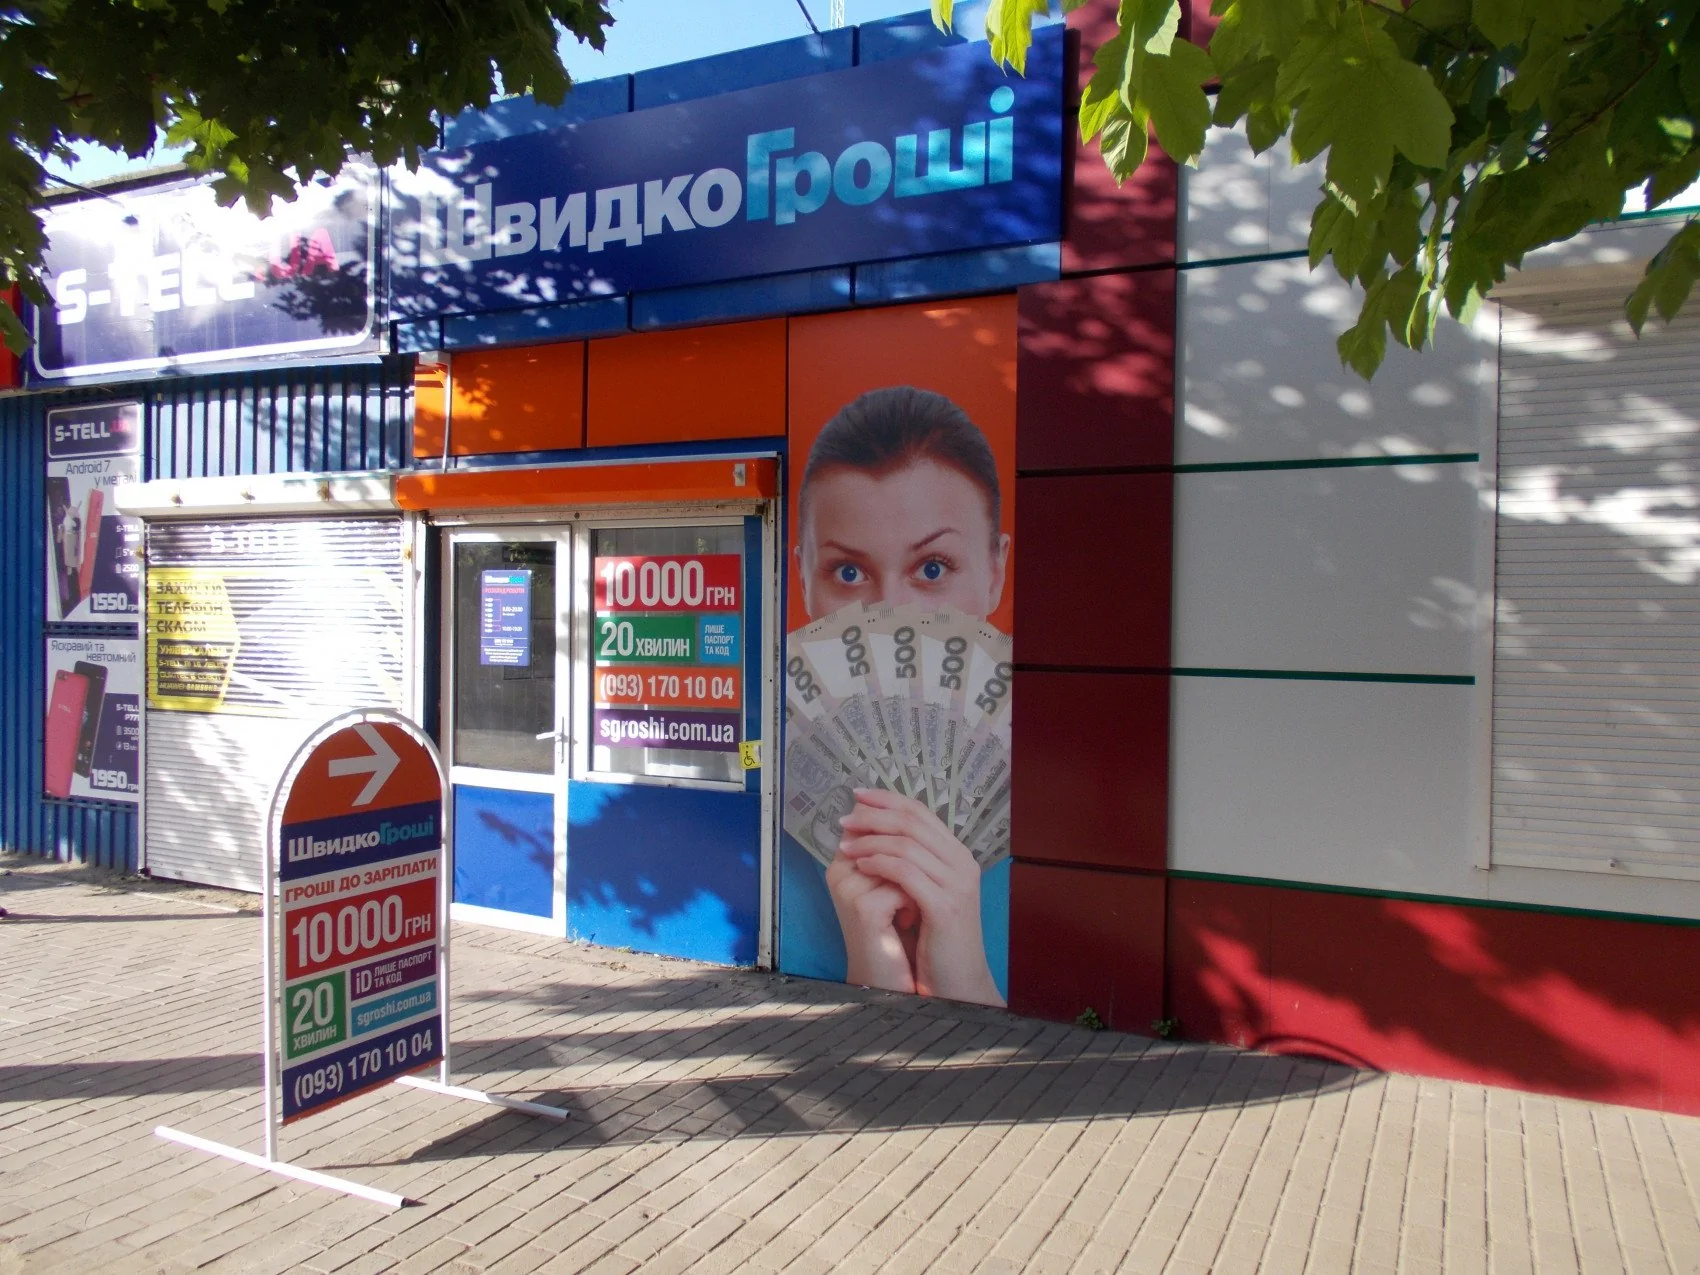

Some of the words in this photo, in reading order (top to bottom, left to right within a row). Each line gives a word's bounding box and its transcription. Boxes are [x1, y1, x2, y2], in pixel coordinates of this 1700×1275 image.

[419, 86, 1015, 267] ШвидкоГроші
[65, 461, 103, 475] Android
[104, 460, 111, 474] 7
[600, 561, 636, 607] 10
[640, 560, 704, 607] 000
[706, 586, 735, 606] ГРН
[91, 592, 128, 611] 1550
[600, 621, 634, 656] 20
[636, 638, 690, 657] ХВИЛИН
[704, 624, 725, 634] ЛИШЕ
[704, 635, 735, 645] ПАСПОРТ
[51, 639, 93, 652] Яскравий
[94, 641, 105, 652] та
[86, 652, 137, 663] невтомний
[705, 646, 715, 655] ТА
[715, 646, 730, 656] КОД
[841, 624, 871, 679] 500
[893, 625, 917, 679] 500
[940, 635, 968, 691] 500
[600, 674, 644, 702] (093)
[647, 675, 680, 698] 170
[683, 676, 707, 699] 10
[711, 676, 735, 700] 04
[787, 656, 822, 704] 500
[974, 661, 1013, 716] 500
[600, 717, 734, 744] sgroshi.com.ua
[91, 768, 128, 789] 1950
[288, 815, 434, 863] ШвидкоГроші
[285, 881, 335, 903] ГРОШІ
[339, 873, 361, 892] ДО
[364, 857, 437, 886] ЗАРПЛАТИ
[292, 911, 333, 968] 10
[337, 894, 403, 956] 000
[404, 914, 431, 939] ГРН
[374, 962, 397, 977] ЛИШЕ
[398, 951, 433, 971] ПАСПОРТ
[374, 978, 385, 988] ТА
[386, 971, 403, 985] КОД
[356, 969, 372, 995] iD
[292, 981, 335, 1035] 20
[356, 991, 432, 1027] sgroshi.com.ua
[293, 1024, 338, 1051] ХВИЛИН
[294, 1061, 344, 1107] (093)
[348, 1048, 381, 1081] 170
[385, 1039, 407, 1067] 10
[411, 1029, 433, 1057] 04
